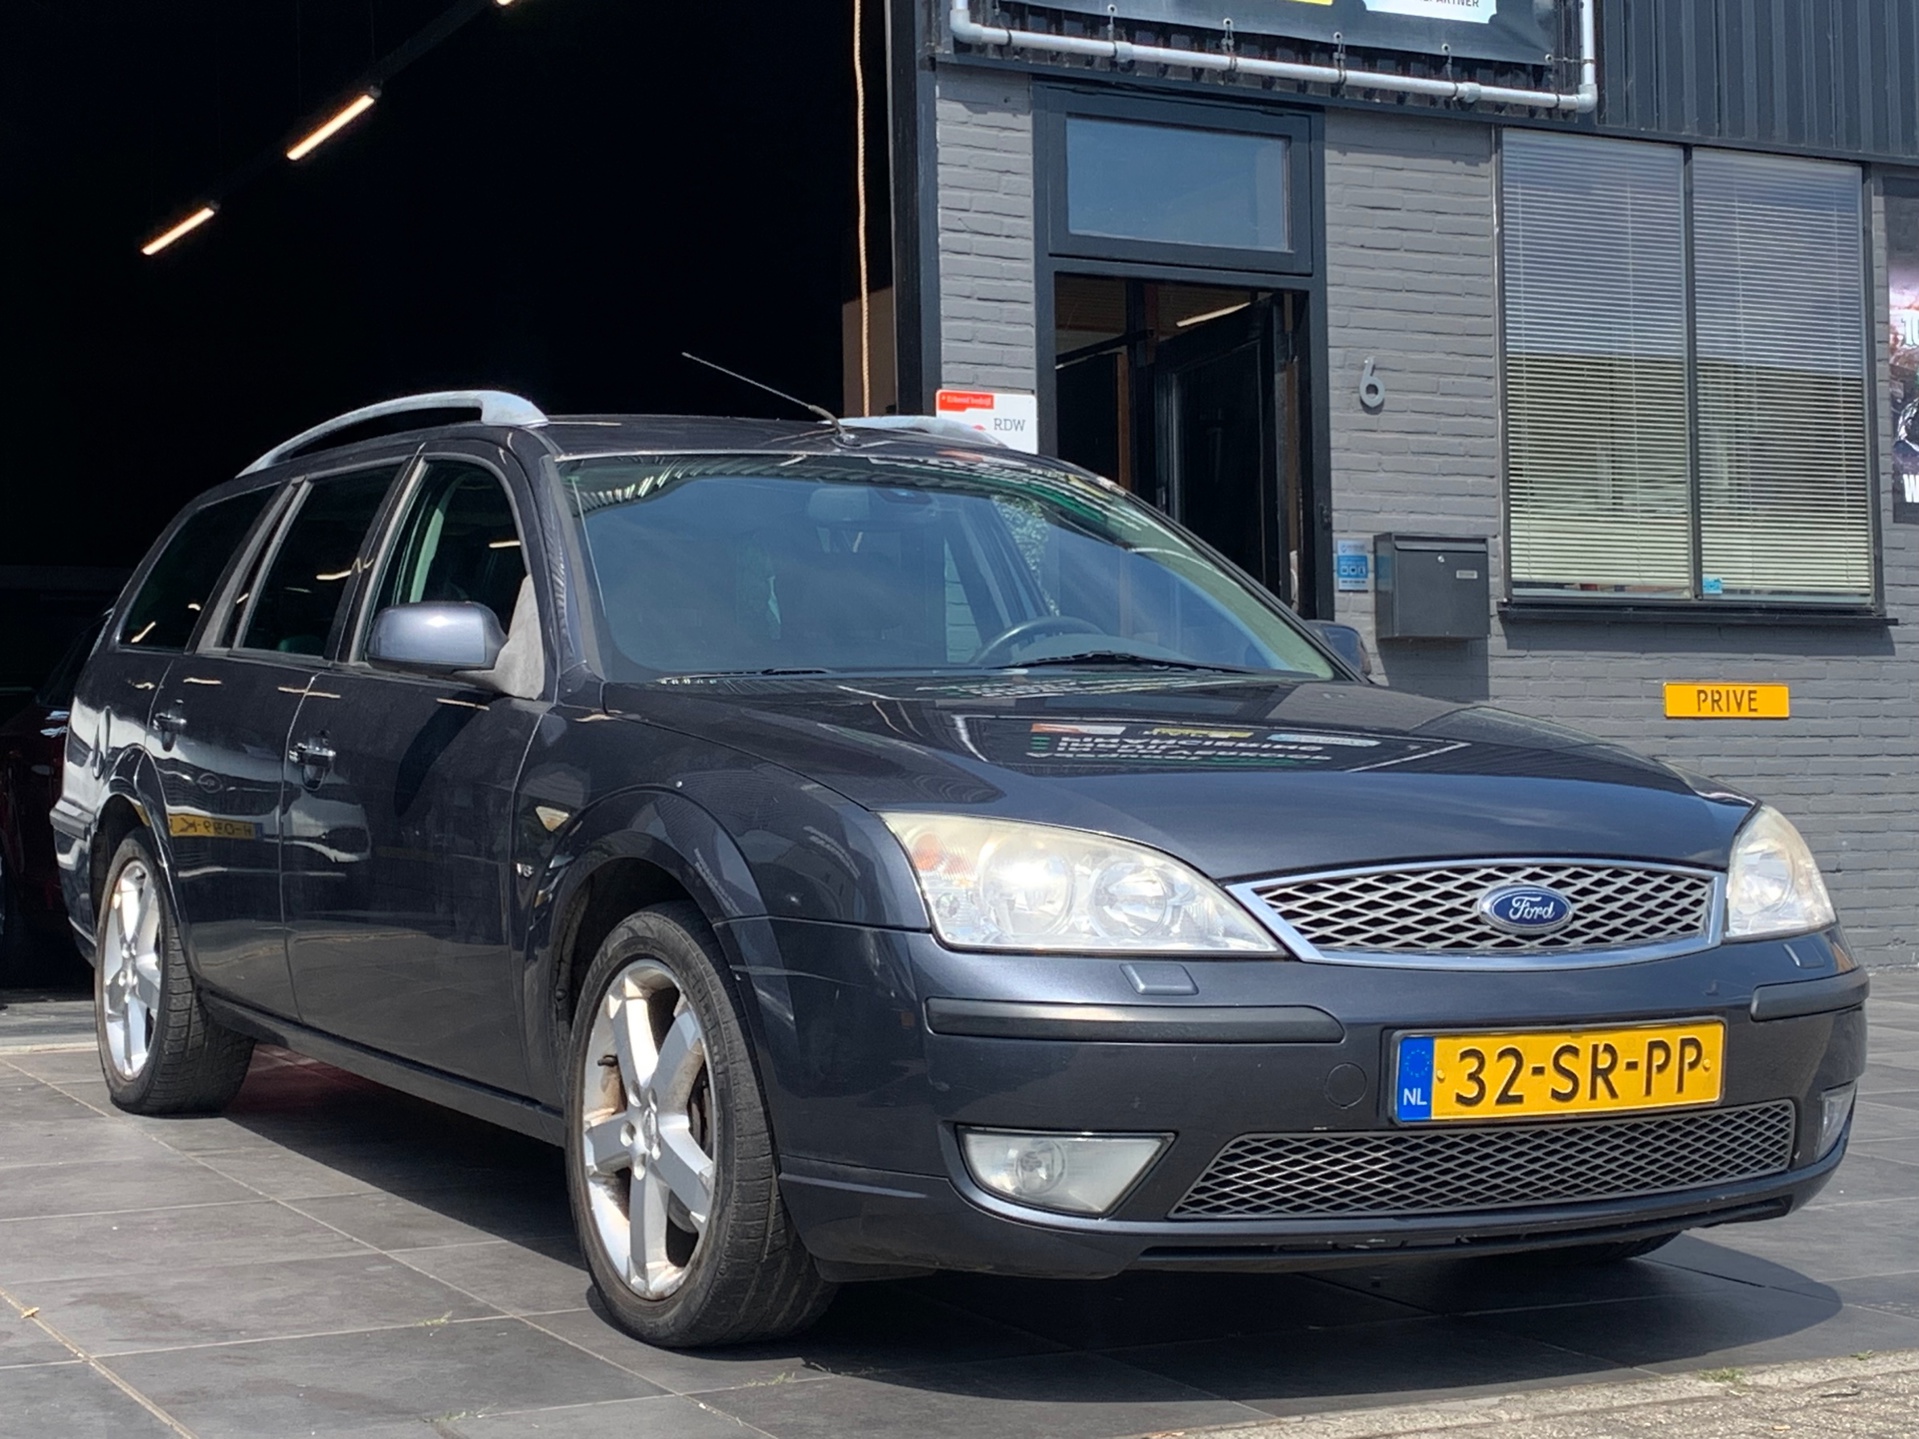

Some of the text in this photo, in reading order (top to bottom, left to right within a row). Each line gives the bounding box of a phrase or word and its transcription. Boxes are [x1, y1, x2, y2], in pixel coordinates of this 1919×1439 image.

[1360, 356, 1385, 408] 6
[994, 418, 1026, 432] RDW
[1696, 689, 1758, 713] PRIVE
[1508, 895, 1556, 921] Ford
[1454, 1036, 1703, 1107] 32-SR-PP
[1402, 1087, 1428, 1106] NL
